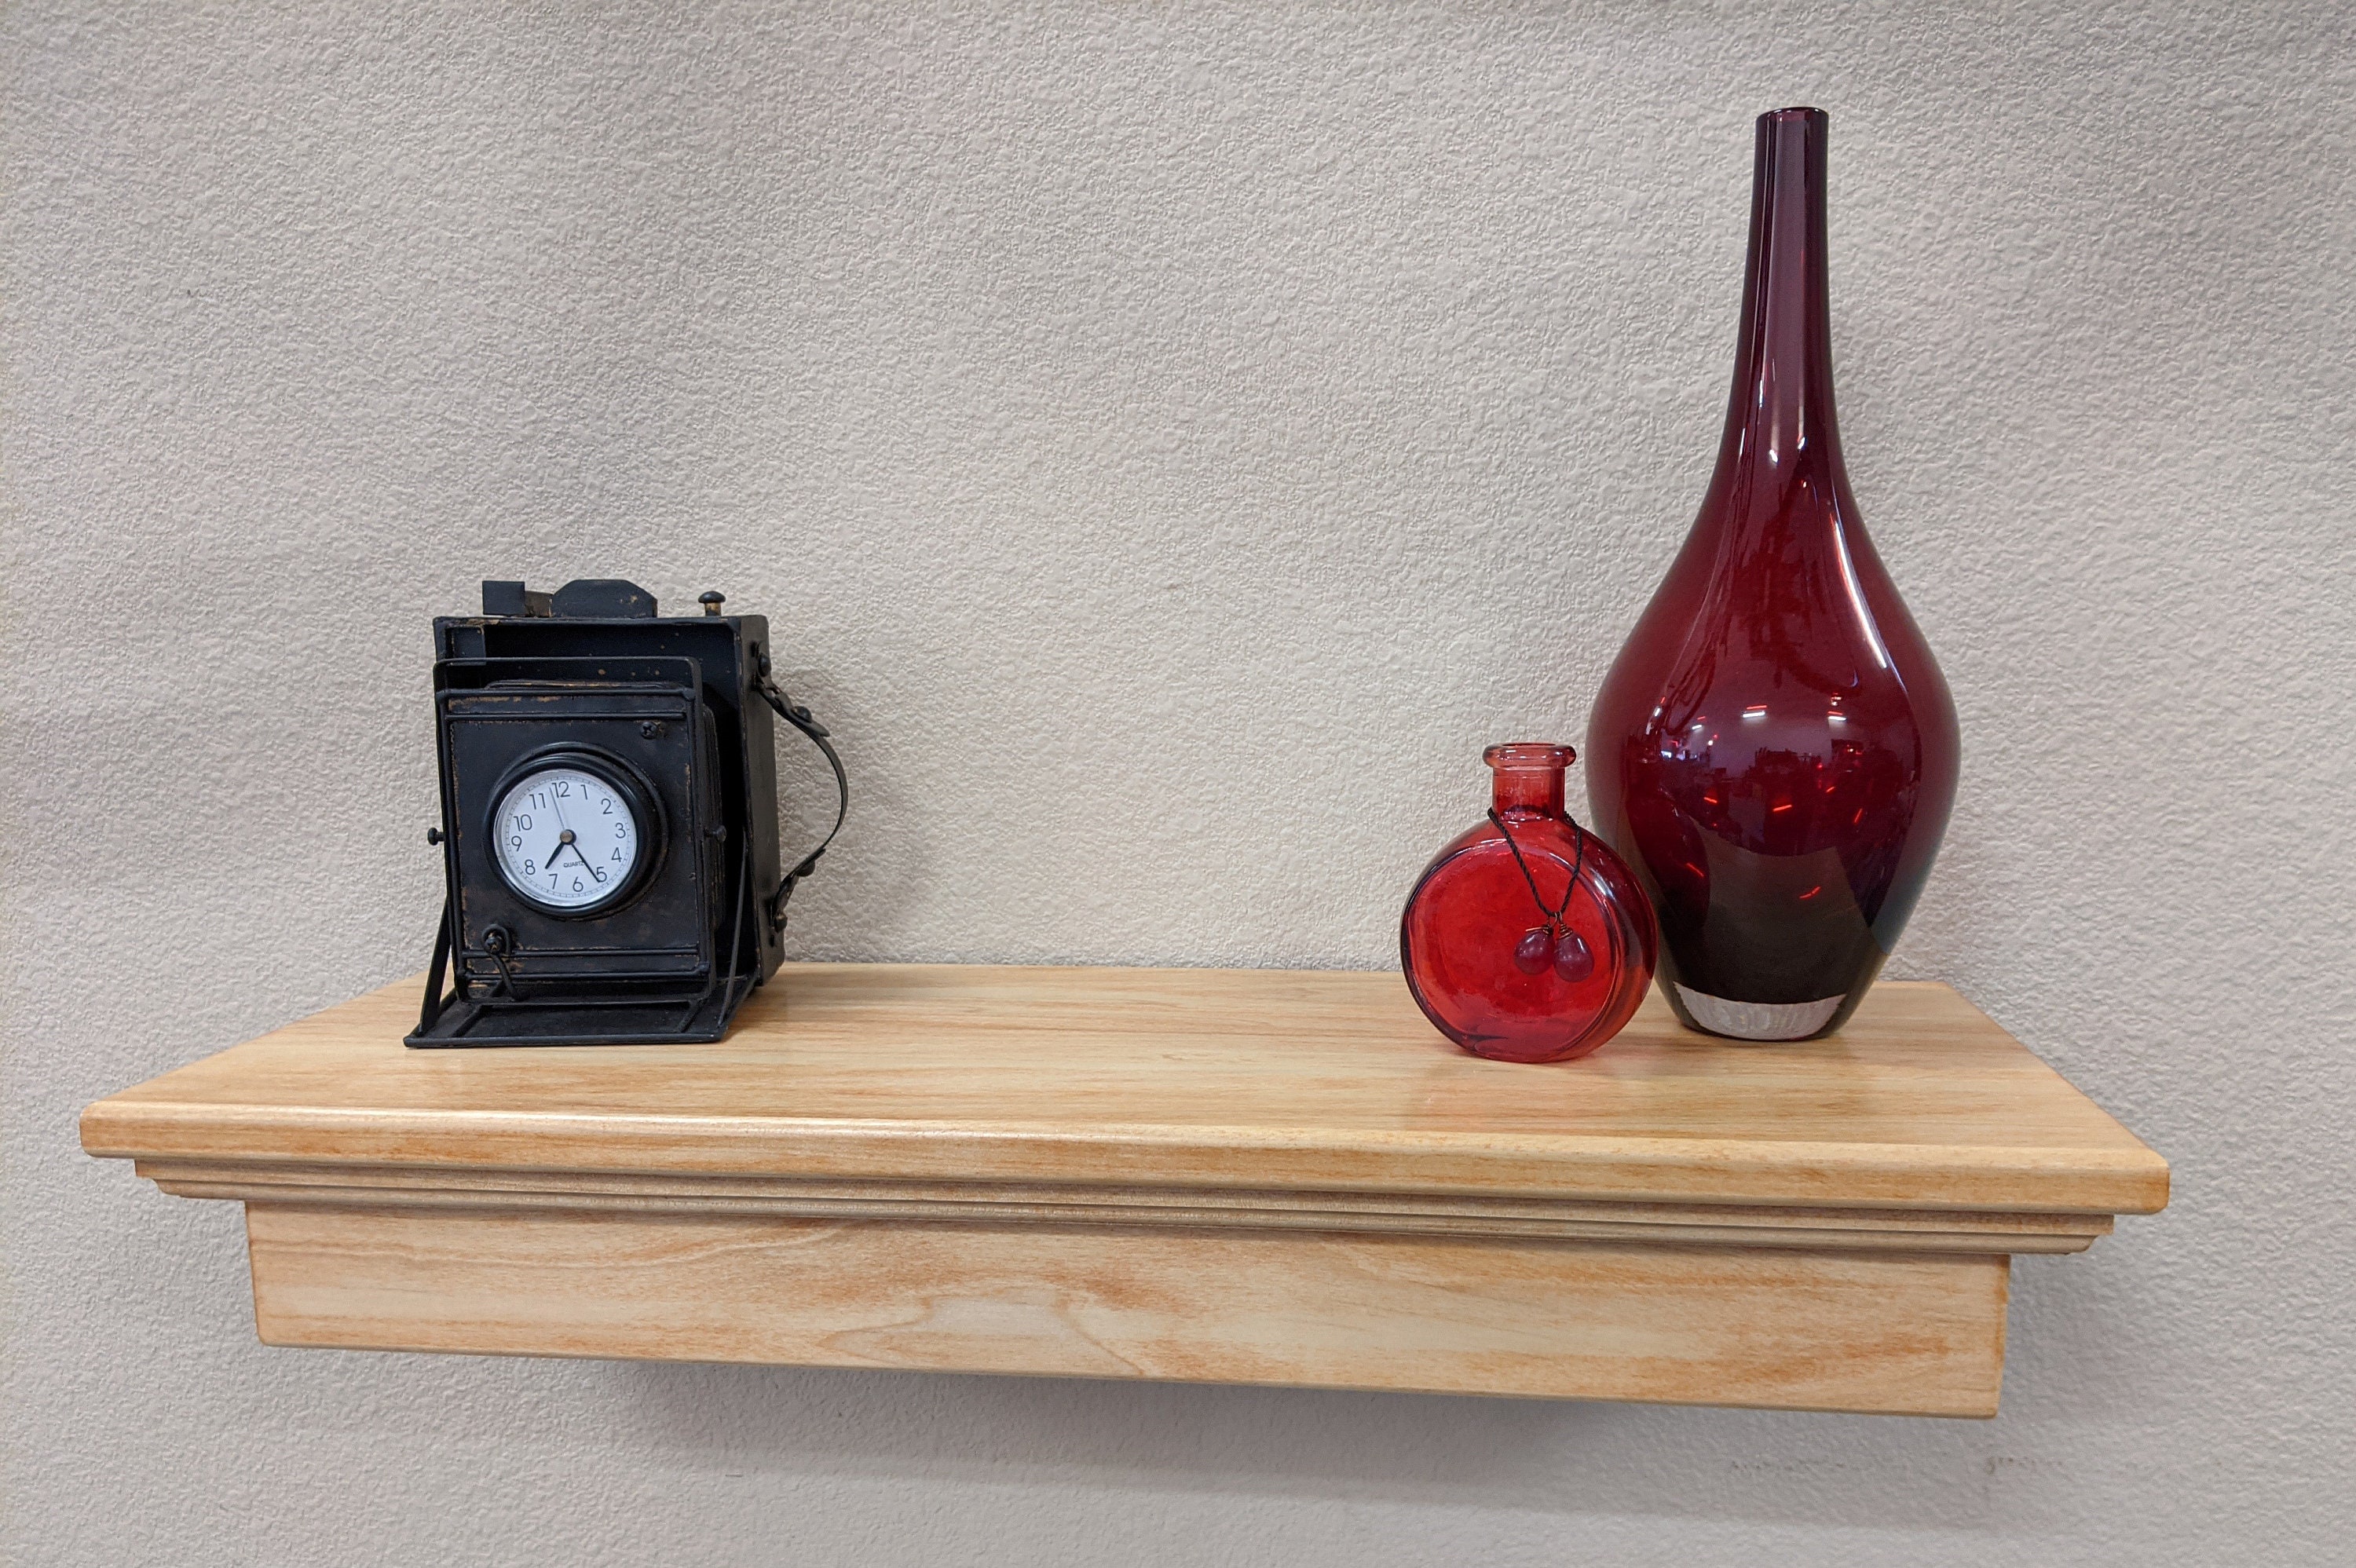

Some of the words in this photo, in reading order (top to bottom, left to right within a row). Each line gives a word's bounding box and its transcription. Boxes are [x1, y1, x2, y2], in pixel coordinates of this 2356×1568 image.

[551, 781, 570, 798] 12
[580, 784, 588, 800] 1
[529, 793, 546, 810] 11
[601, 799, 613, 814] 2
[514, 814, 532, 832] 10
[615, 822, 626, 839] 3
[511, 835, 522, 852] 9
[611, 846, 623, 863] 4
[525, 859, 536, 875] 8
[596, 866, 608, 883] 5
[549, 873, 558, 890] 7
[573, 876, 584, 893] 6
